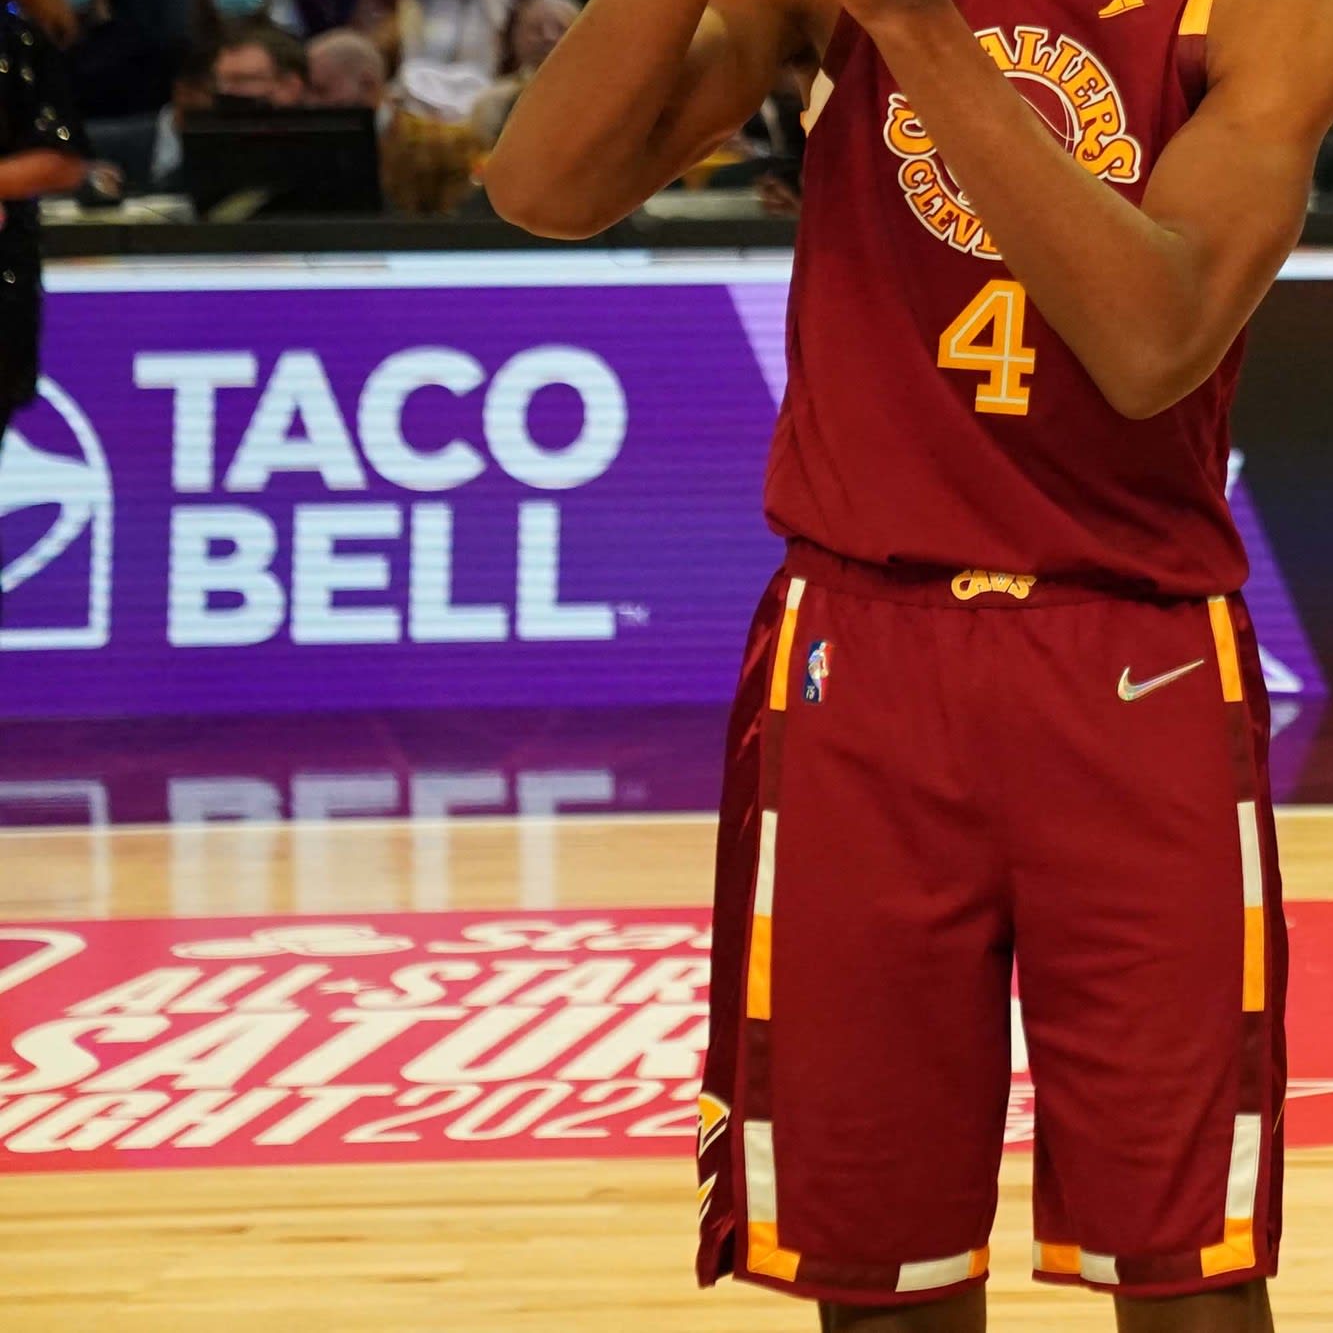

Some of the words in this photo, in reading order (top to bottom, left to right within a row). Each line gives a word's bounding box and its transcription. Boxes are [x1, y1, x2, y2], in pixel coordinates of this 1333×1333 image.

[132, 344, 630, 493] TACO
[937, 279, 1036, 416] 4
[167, 499, 617, 648] BELL
[64, 965, 333, 1017] ALL
